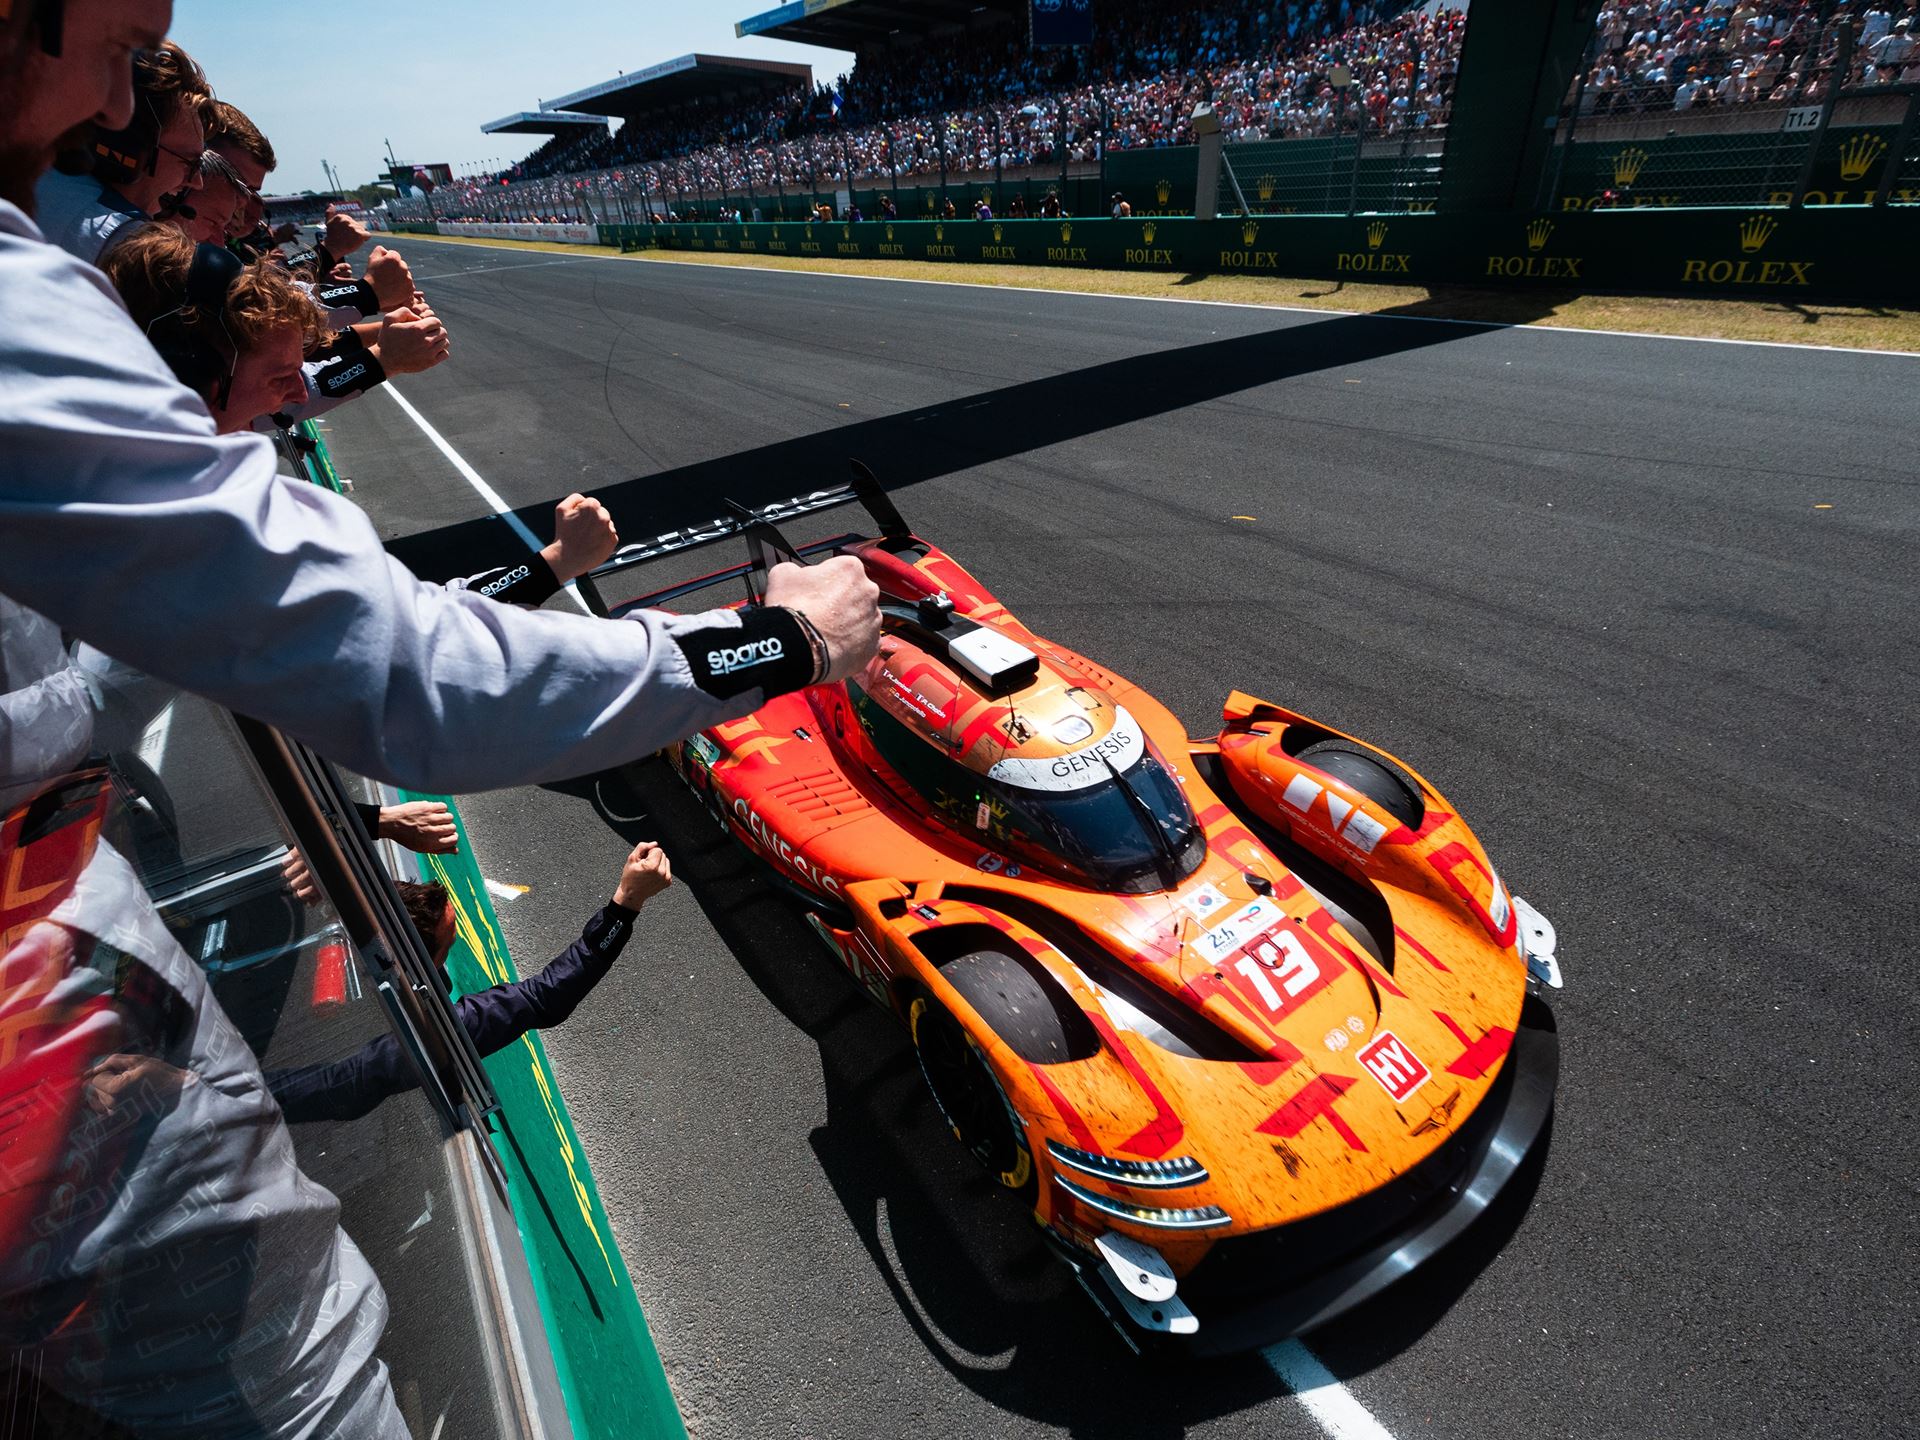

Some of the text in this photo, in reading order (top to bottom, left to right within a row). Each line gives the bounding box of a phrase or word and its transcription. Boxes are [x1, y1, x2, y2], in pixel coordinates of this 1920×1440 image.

[1788, 110, 1819, 127] T1.2
[837, 243, 860, 254] ROLEX
[879, 243, 904, 255] ROLEX
[926, 245, 955, 257] ROLEX
[982, 245, 1016, 259] ROLEX
[1047, 247, 1087, 262] ROLEX
[1125, 249, 1173, 265] ROLEX
[1220, 251, 1279, 268] ROLEX
[1337, 253, 1411, 273] ROLEX
[1486, 256, 1583, 278] ROLEX
[1681, 260, 1815, 285] ROLEX
[320, 285, 359, 299] sparco
[327, 363, 366, 389] sparco
[480, 565, 529, 596] sparco
[707, 637, 784, 675] sparco
[1051, 731, 1131, 777] GENESIS
[734, 798, 845, 902] GENESIS
[1233, 929, 1320, 1012] 19
[1366, 1039, 1417, 1092] HY
